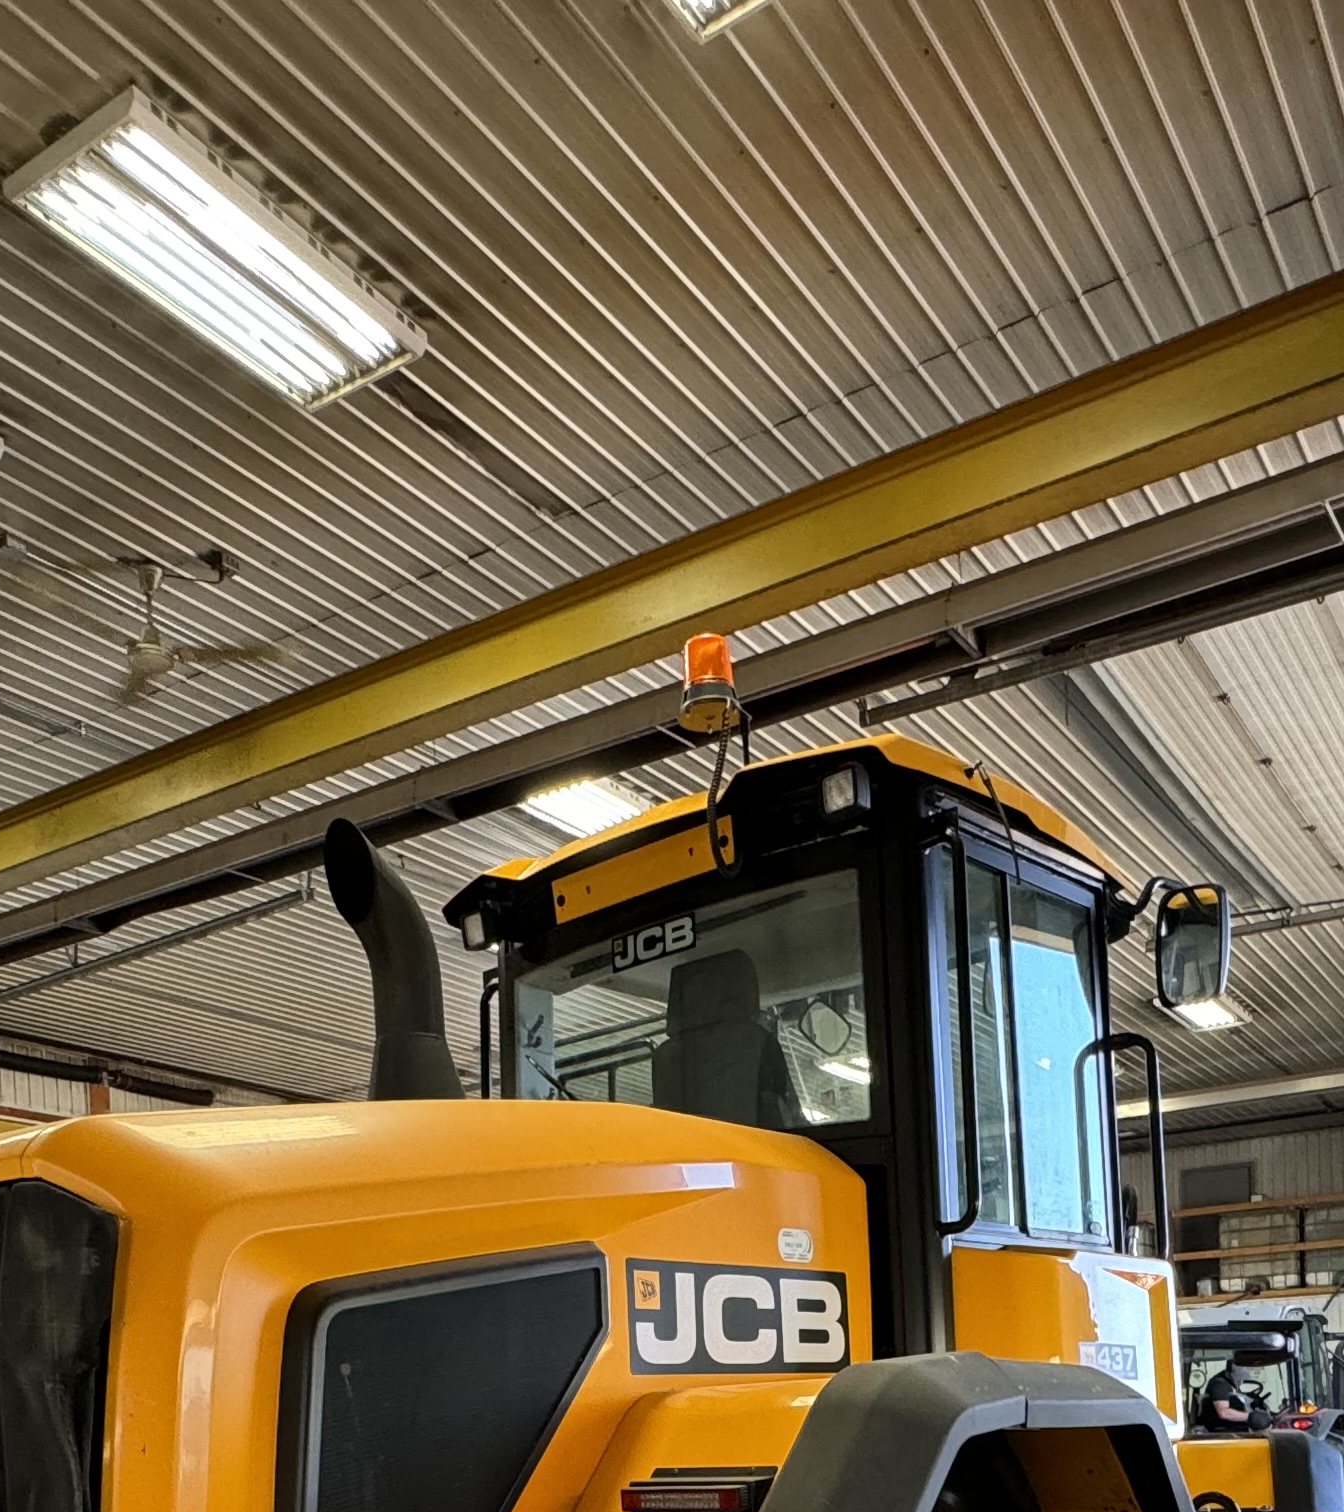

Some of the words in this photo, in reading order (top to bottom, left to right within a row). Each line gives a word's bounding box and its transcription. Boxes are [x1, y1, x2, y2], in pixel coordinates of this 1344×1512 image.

[614, 916, 694, 968] JCB
[635, 1272, 845, 1364] JCB
[1097, 1346, 1134, 1371] 437
